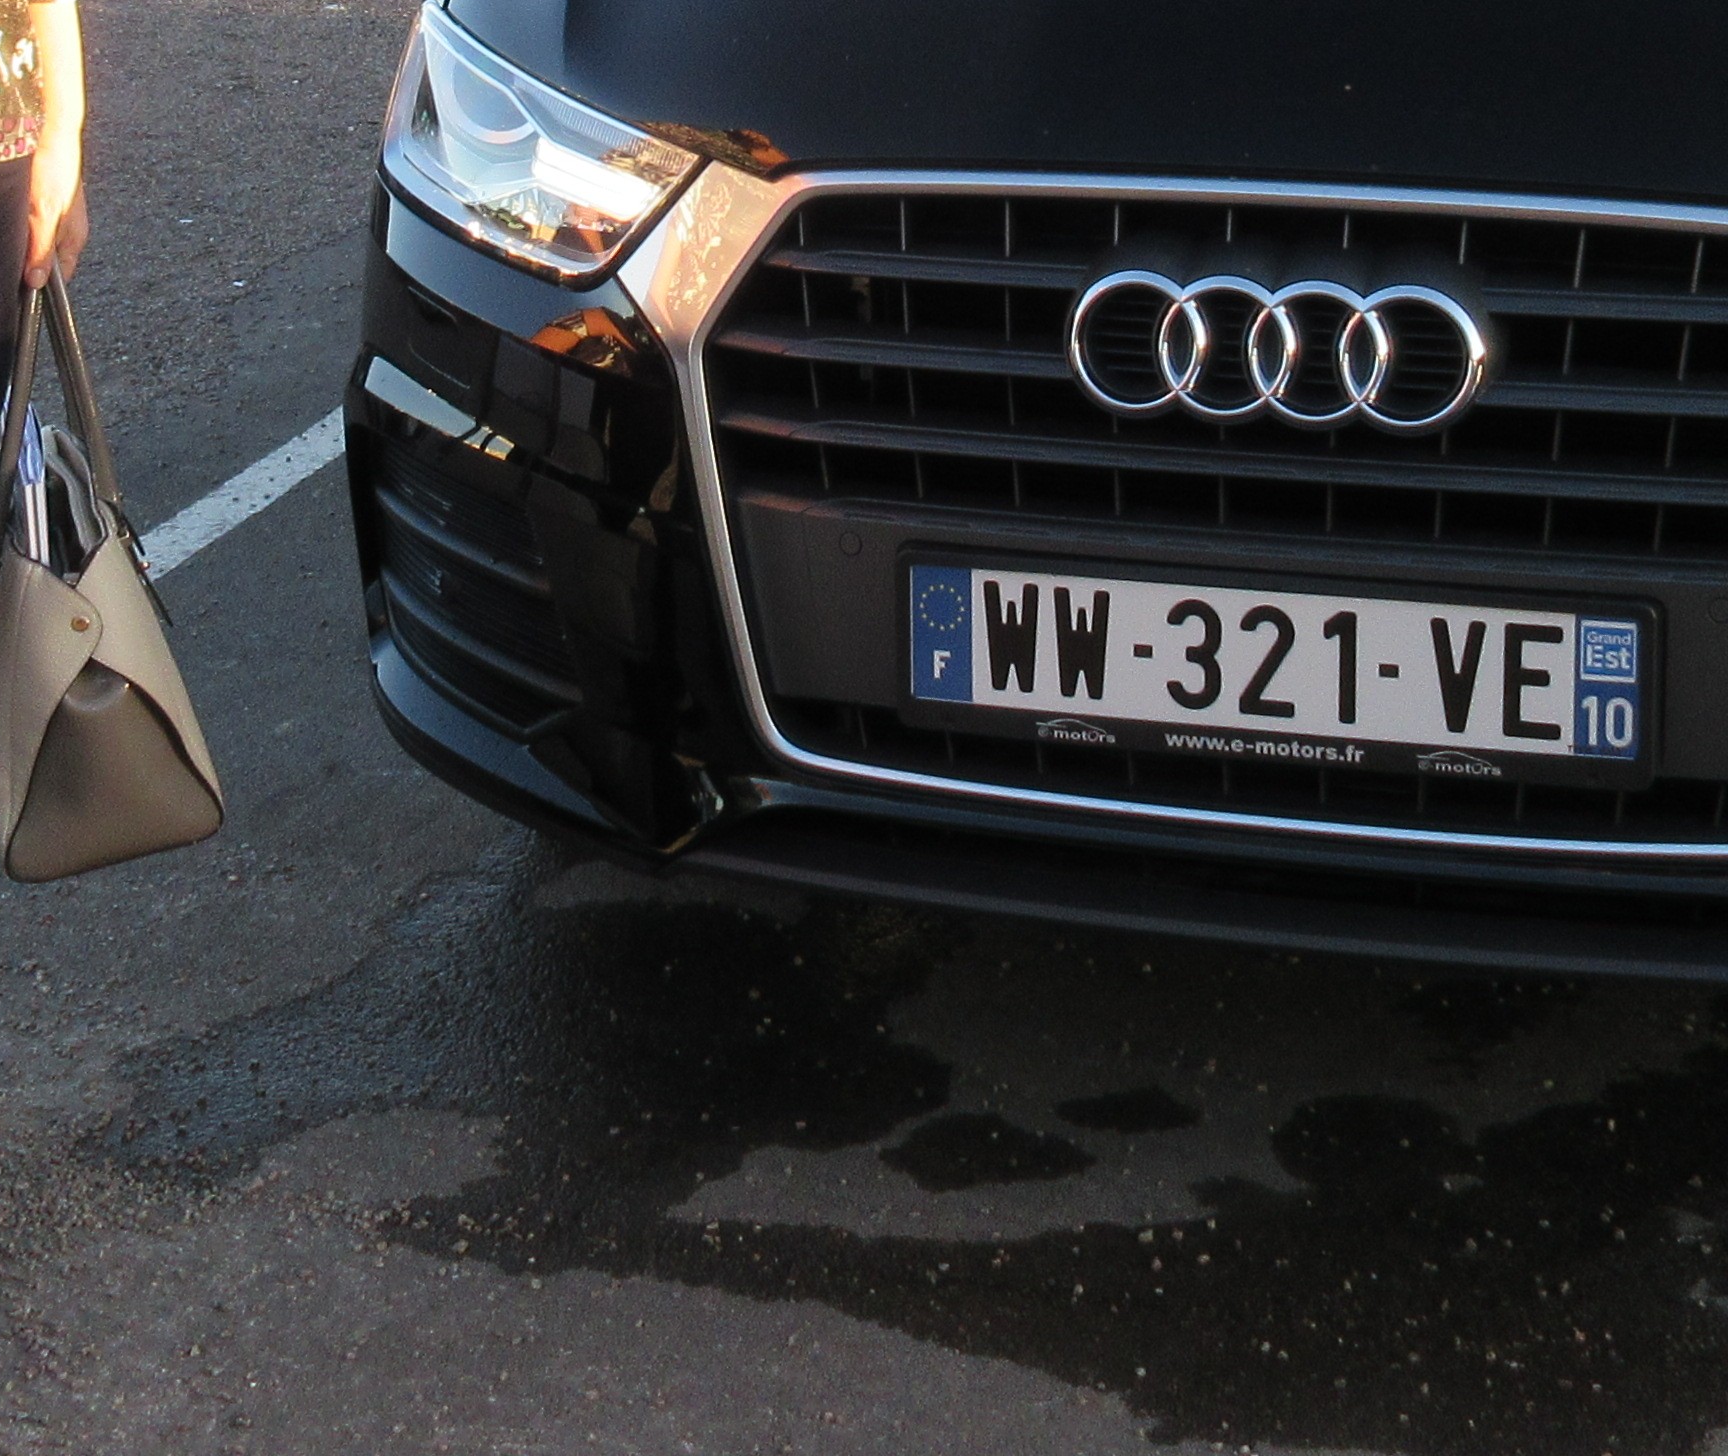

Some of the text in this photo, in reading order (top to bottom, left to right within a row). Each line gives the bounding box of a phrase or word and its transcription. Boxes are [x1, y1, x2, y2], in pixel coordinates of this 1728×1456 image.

[1585, 630, 1632, 646] Grand
[932, 650, 952, 680] F
[983, 580, 1564, 741] WW-321-VE
[1585, 644, 1632, 670] Est
[1581, 695, 1634, 748] 10
[1165, 732, 1366, 764] www.e-motors.fr
